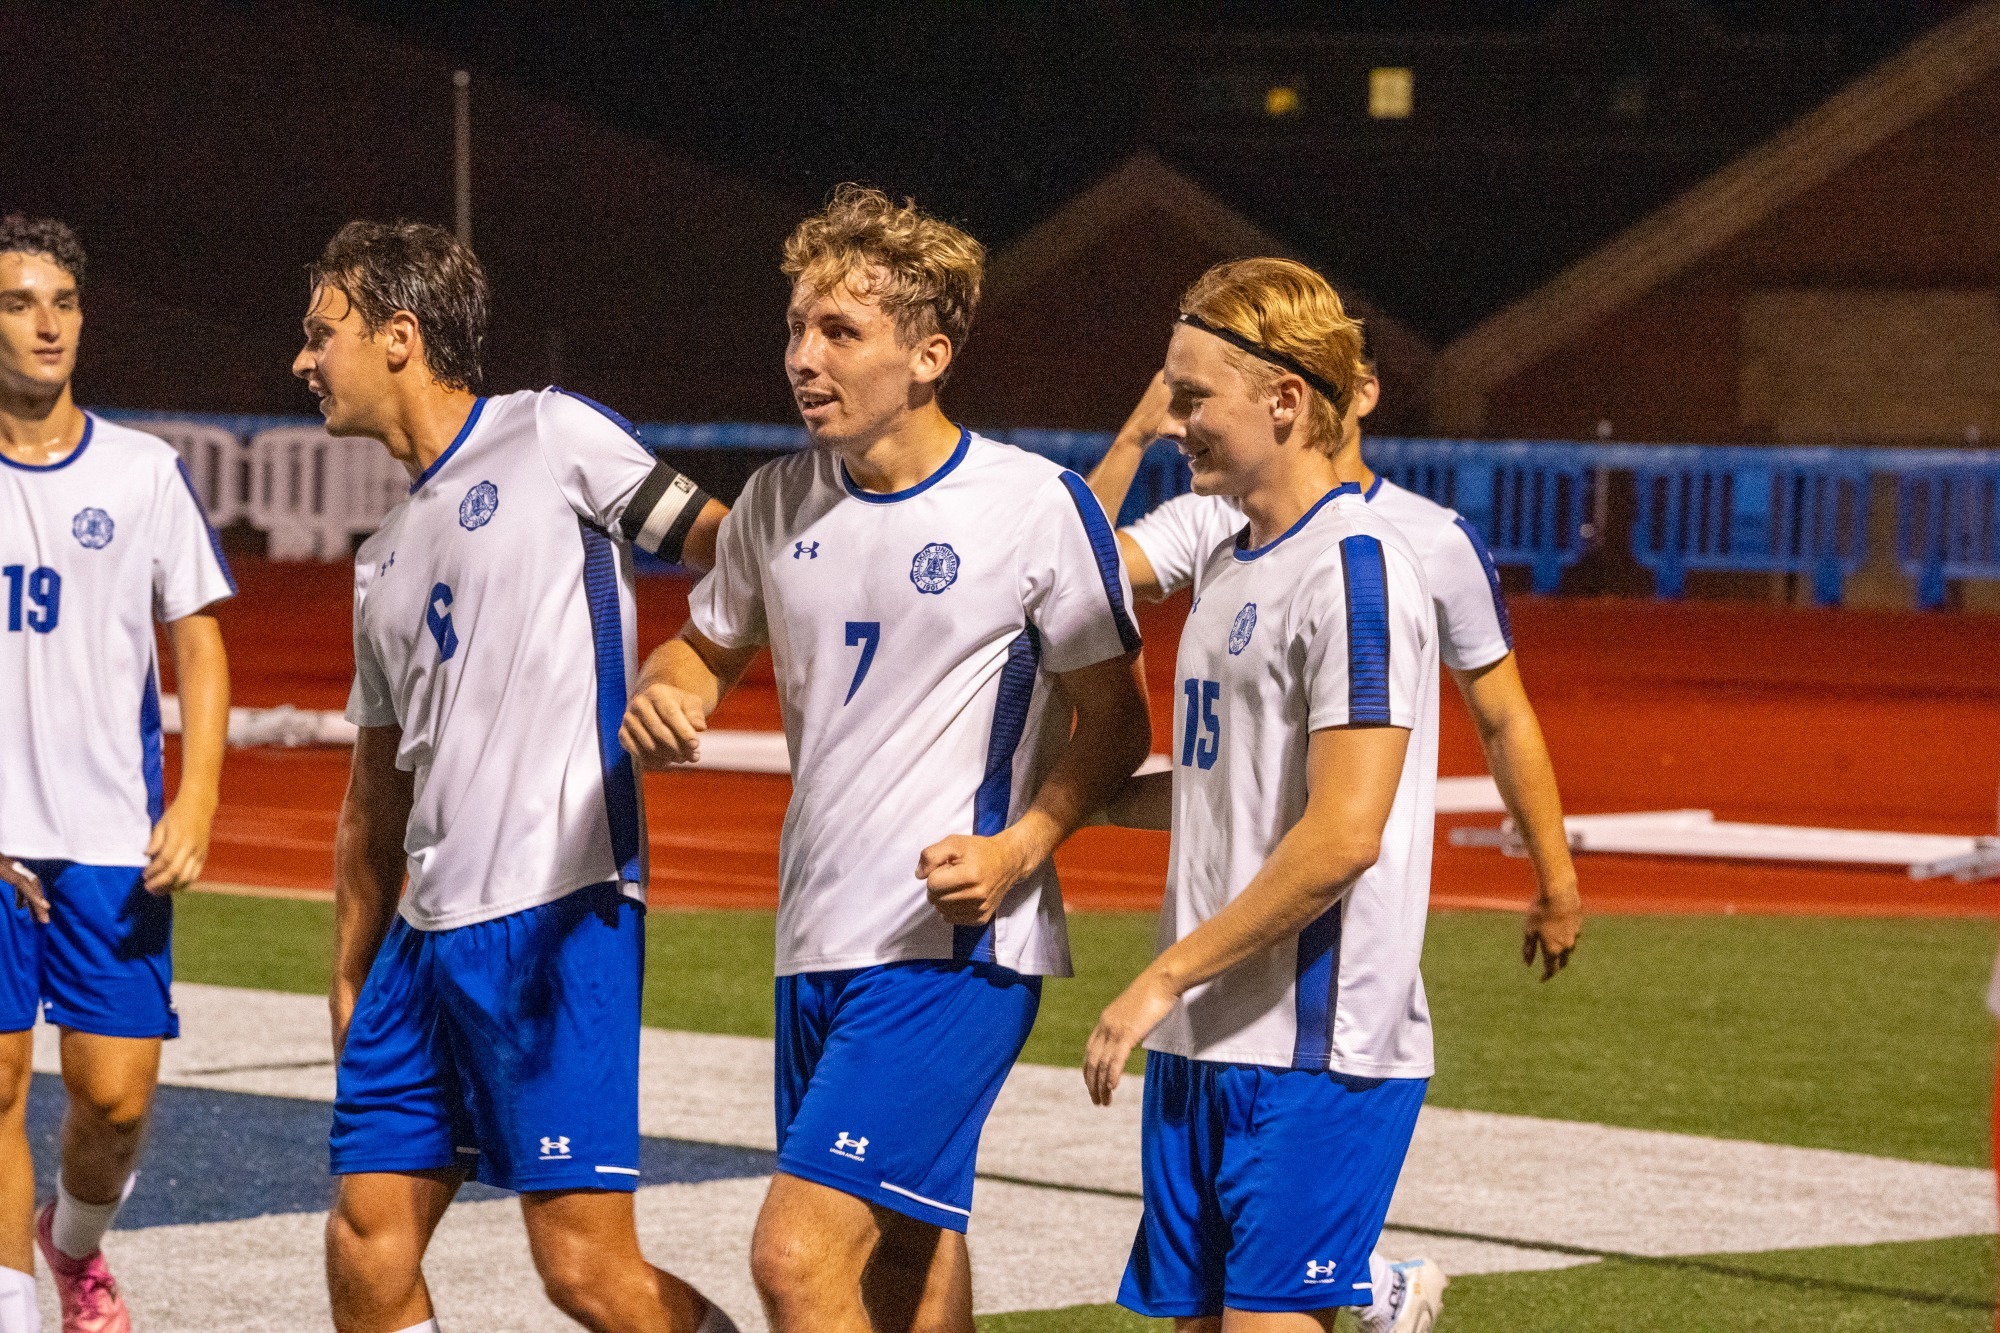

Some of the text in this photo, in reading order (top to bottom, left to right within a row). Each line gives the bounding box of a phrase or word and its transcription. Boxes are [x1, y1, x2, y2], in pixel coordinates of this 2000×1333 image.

[3, 565, 61, 633] 19
[914, 546, 956, 584] MILLIKIN UNIVERSITY
[427, 582, 459, 664] 6
[844, 621, 880, 706] 7
[1181, 678, 1220, 770] 15
